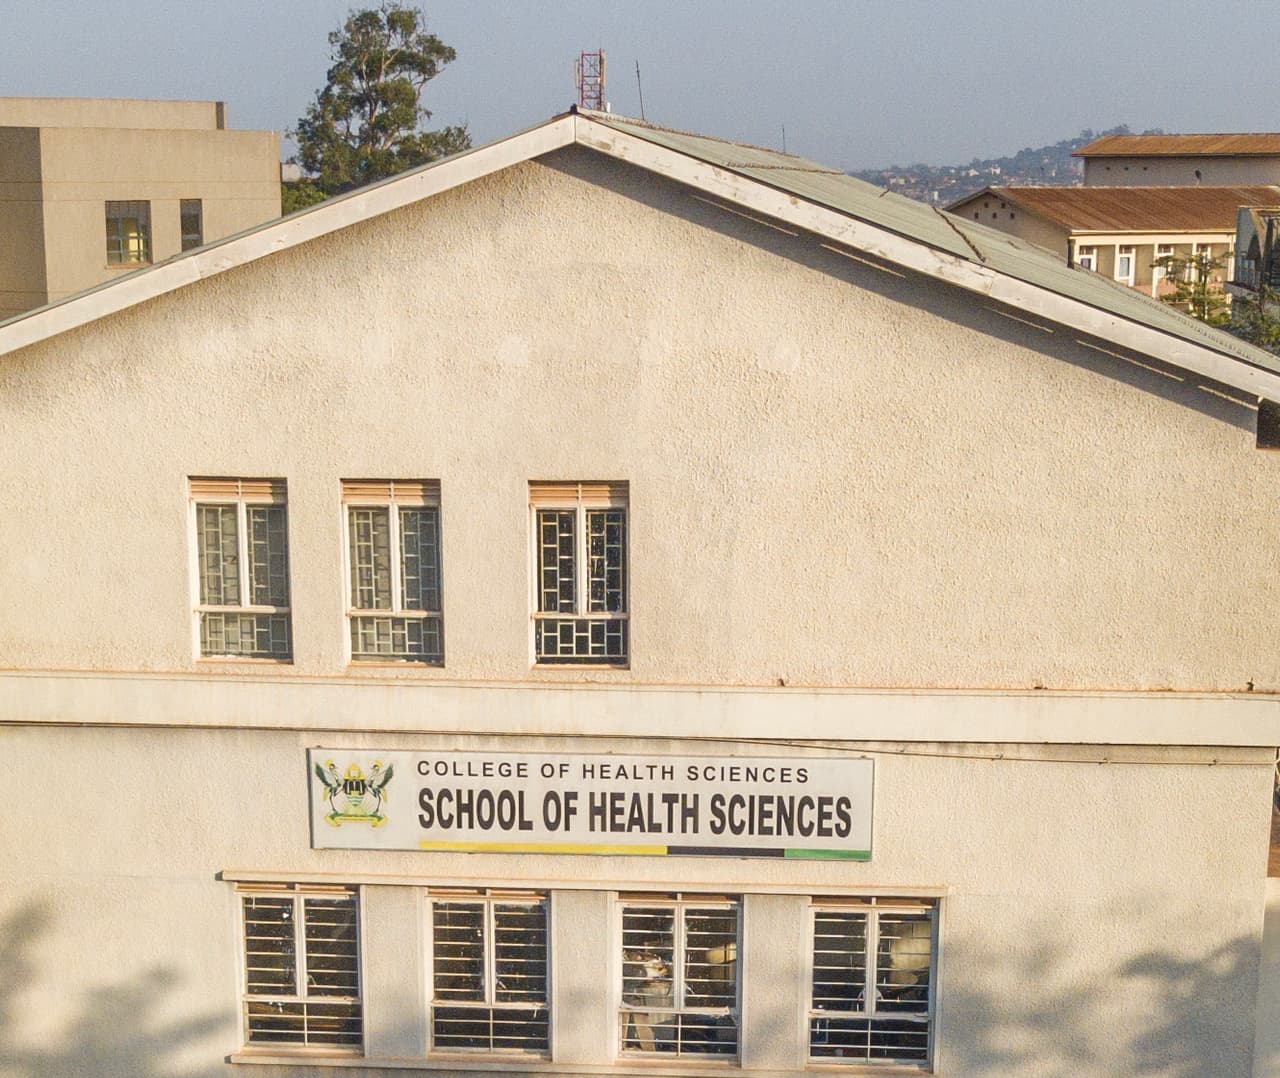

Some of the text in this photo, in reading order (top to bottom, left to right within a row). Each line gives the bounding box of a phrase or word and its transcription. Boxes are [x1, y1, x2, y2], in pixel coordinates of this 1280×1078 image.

[418, 761, 810, 784] COLLEGE OF HEALTH SCIENCES
[419, 788, 853, 838] SCHOOL OF HEALTH SCIENCES
